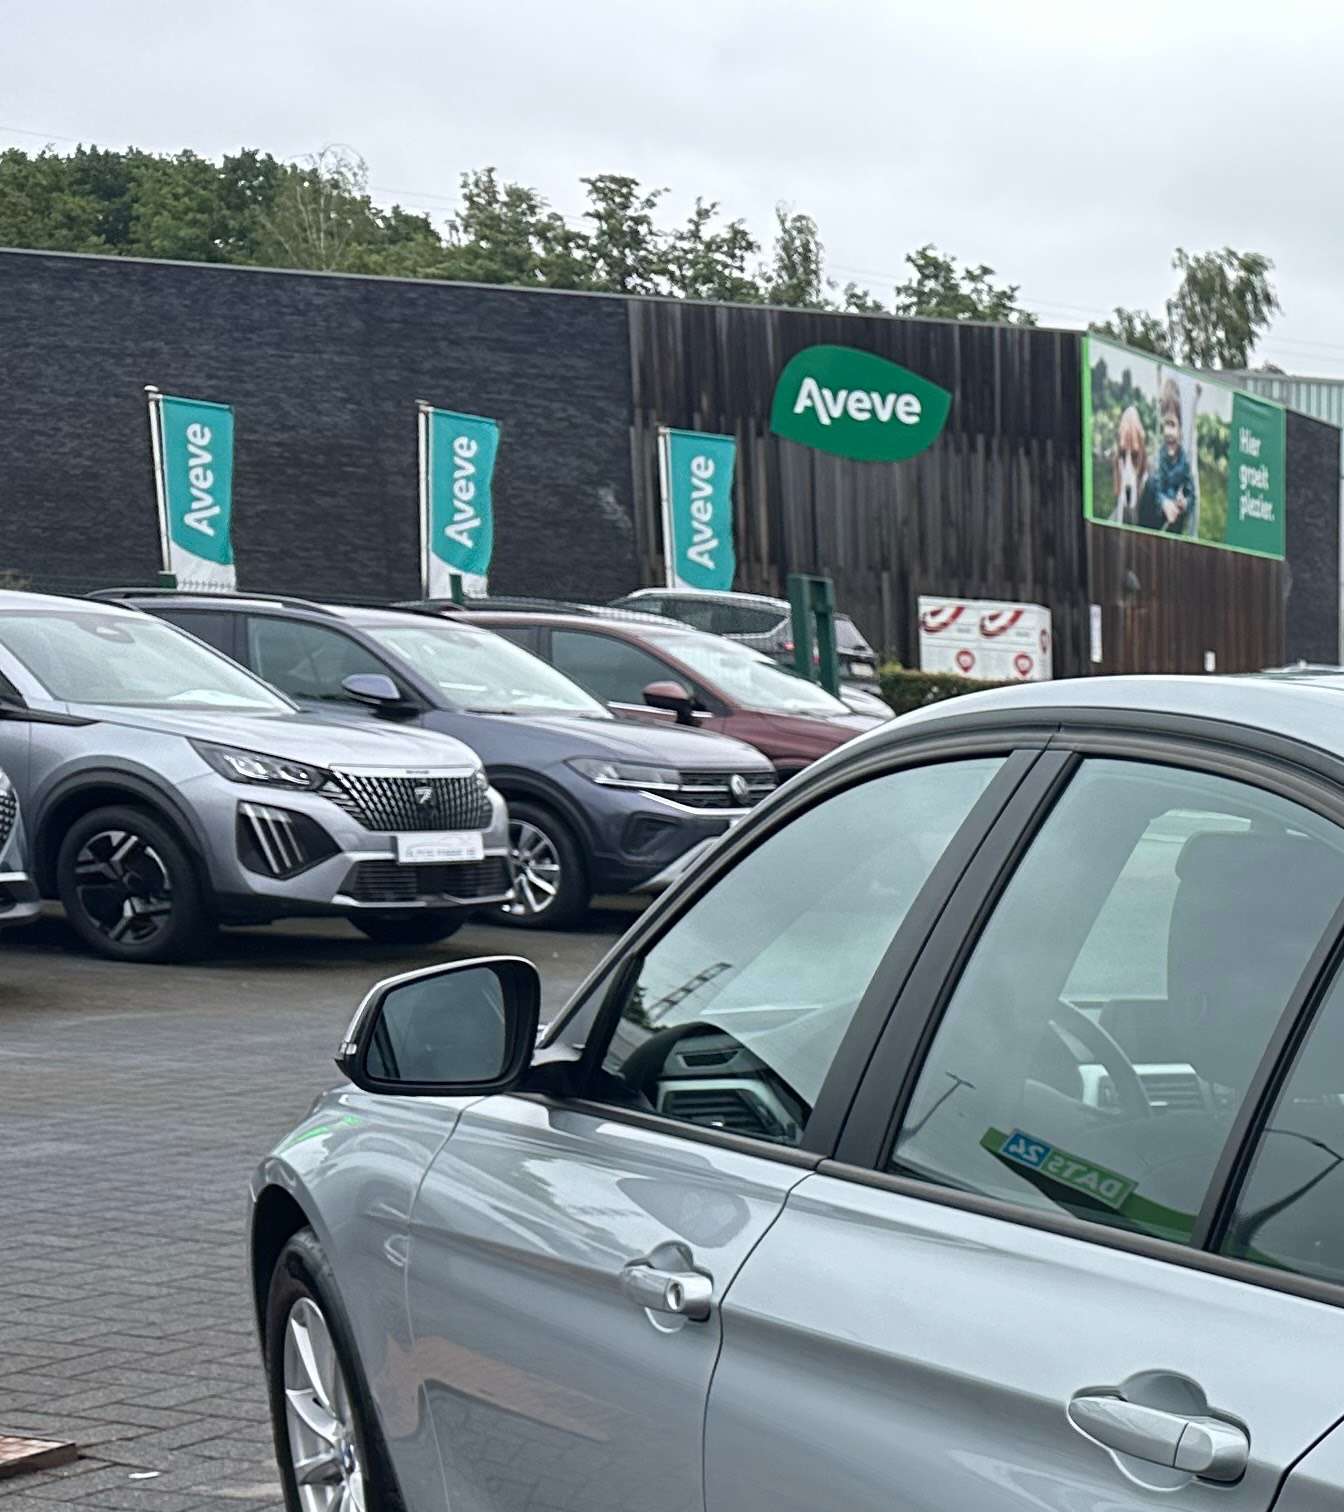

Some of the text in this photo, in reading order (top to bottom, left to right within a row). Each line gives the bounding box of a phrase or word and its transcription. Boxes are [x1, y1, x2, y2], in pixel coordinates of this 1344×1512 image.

[793, 376, 922, 426] Aveve
[1239, 426, 1262, 457] Hier
[183, 422, 221, 537] Aveve
[444, 434, 482, 549] Aveve
[686, 454, 720, 571] Aveve
[1239, 463, 1270, 491] groeit
